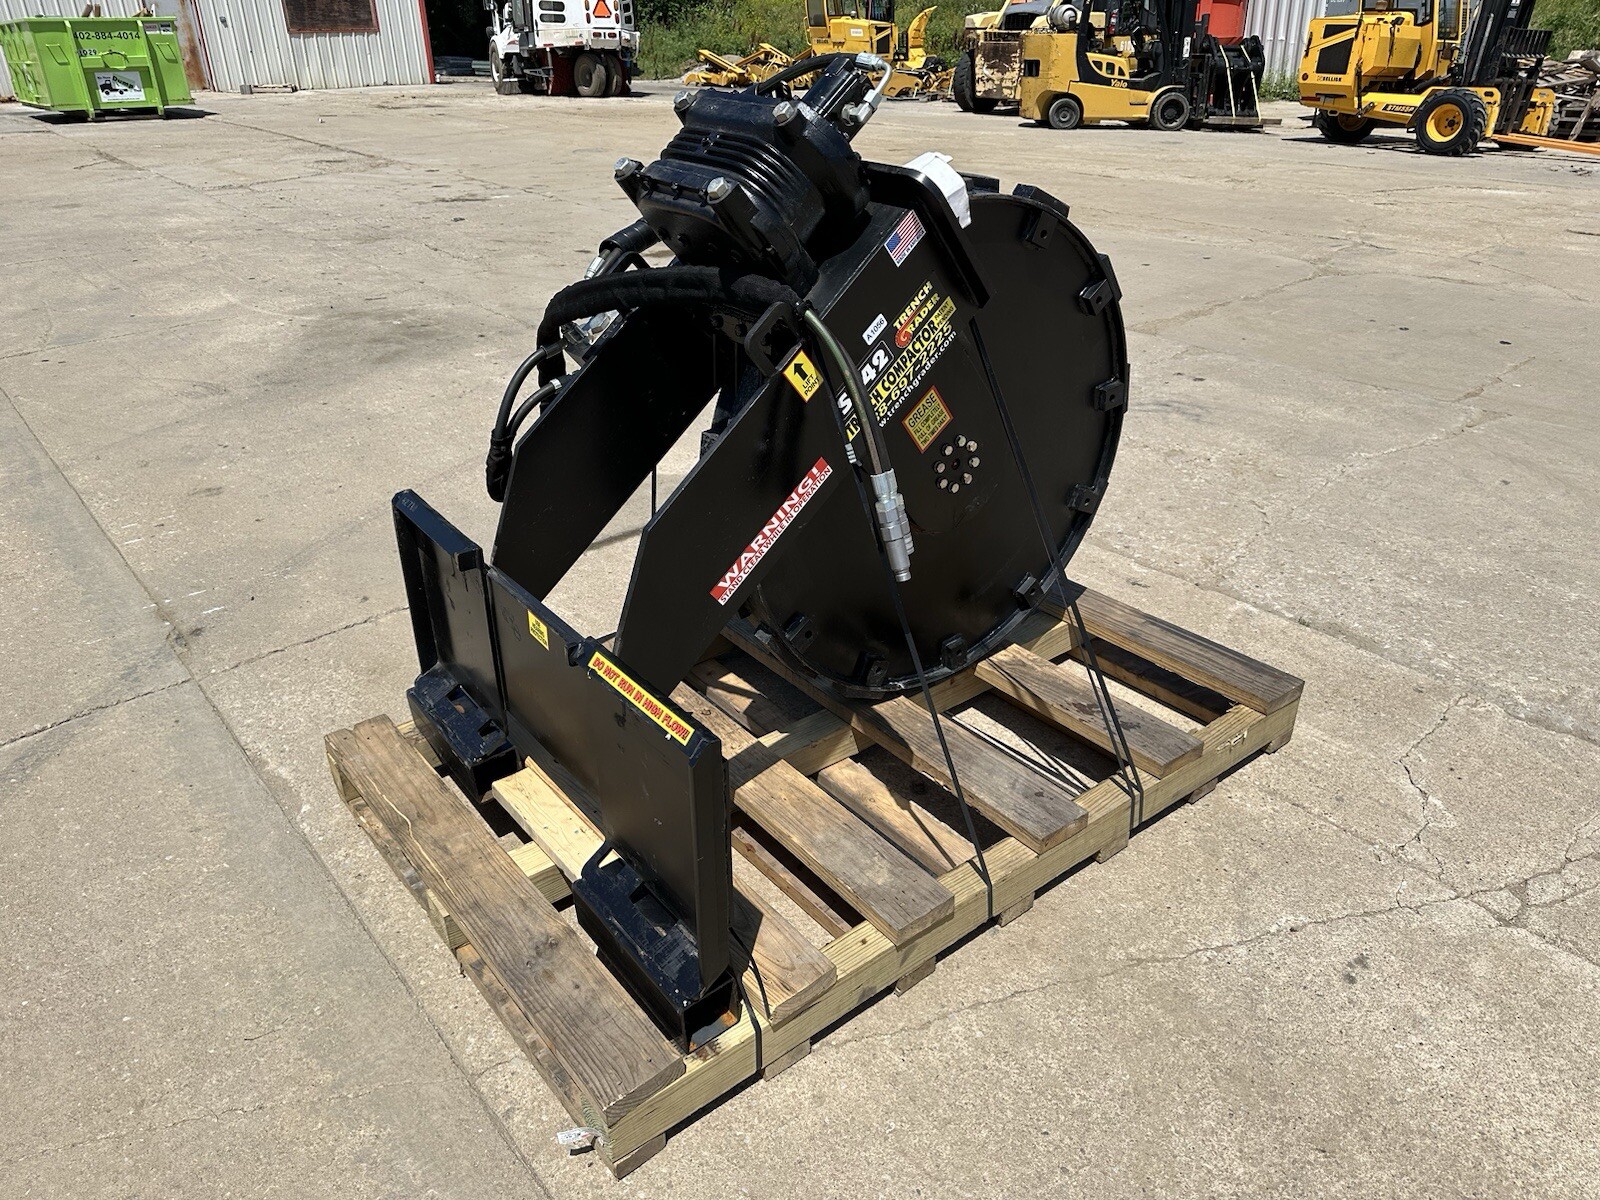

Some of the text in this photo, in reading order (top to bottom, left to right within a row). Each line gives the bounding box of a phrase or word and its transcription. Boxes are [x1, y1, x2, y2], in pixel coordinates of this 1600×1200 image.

[74, 31, 140, 40] 402-884-4014
[892, 280, 934, 330] TRENCH
[881, 320, 938, 392] COMPACTOR
[802, 373, 815, 390] LIFT
[804, 378, 821, 397] POINT
[908, 392, 937, 428] GREASE
[718, 466, 821, 590] WARNING!
[720, 467, 832, 603] STAND CLEAR WHILE IN OPERATION
[592, 656, 606, 672] DO
[602, 665, 620, 682] NOT
[618, 677, 636, 696] RUN
[633, 690, 645, 704] IN
[642, 697, 664, 720] HIGH
